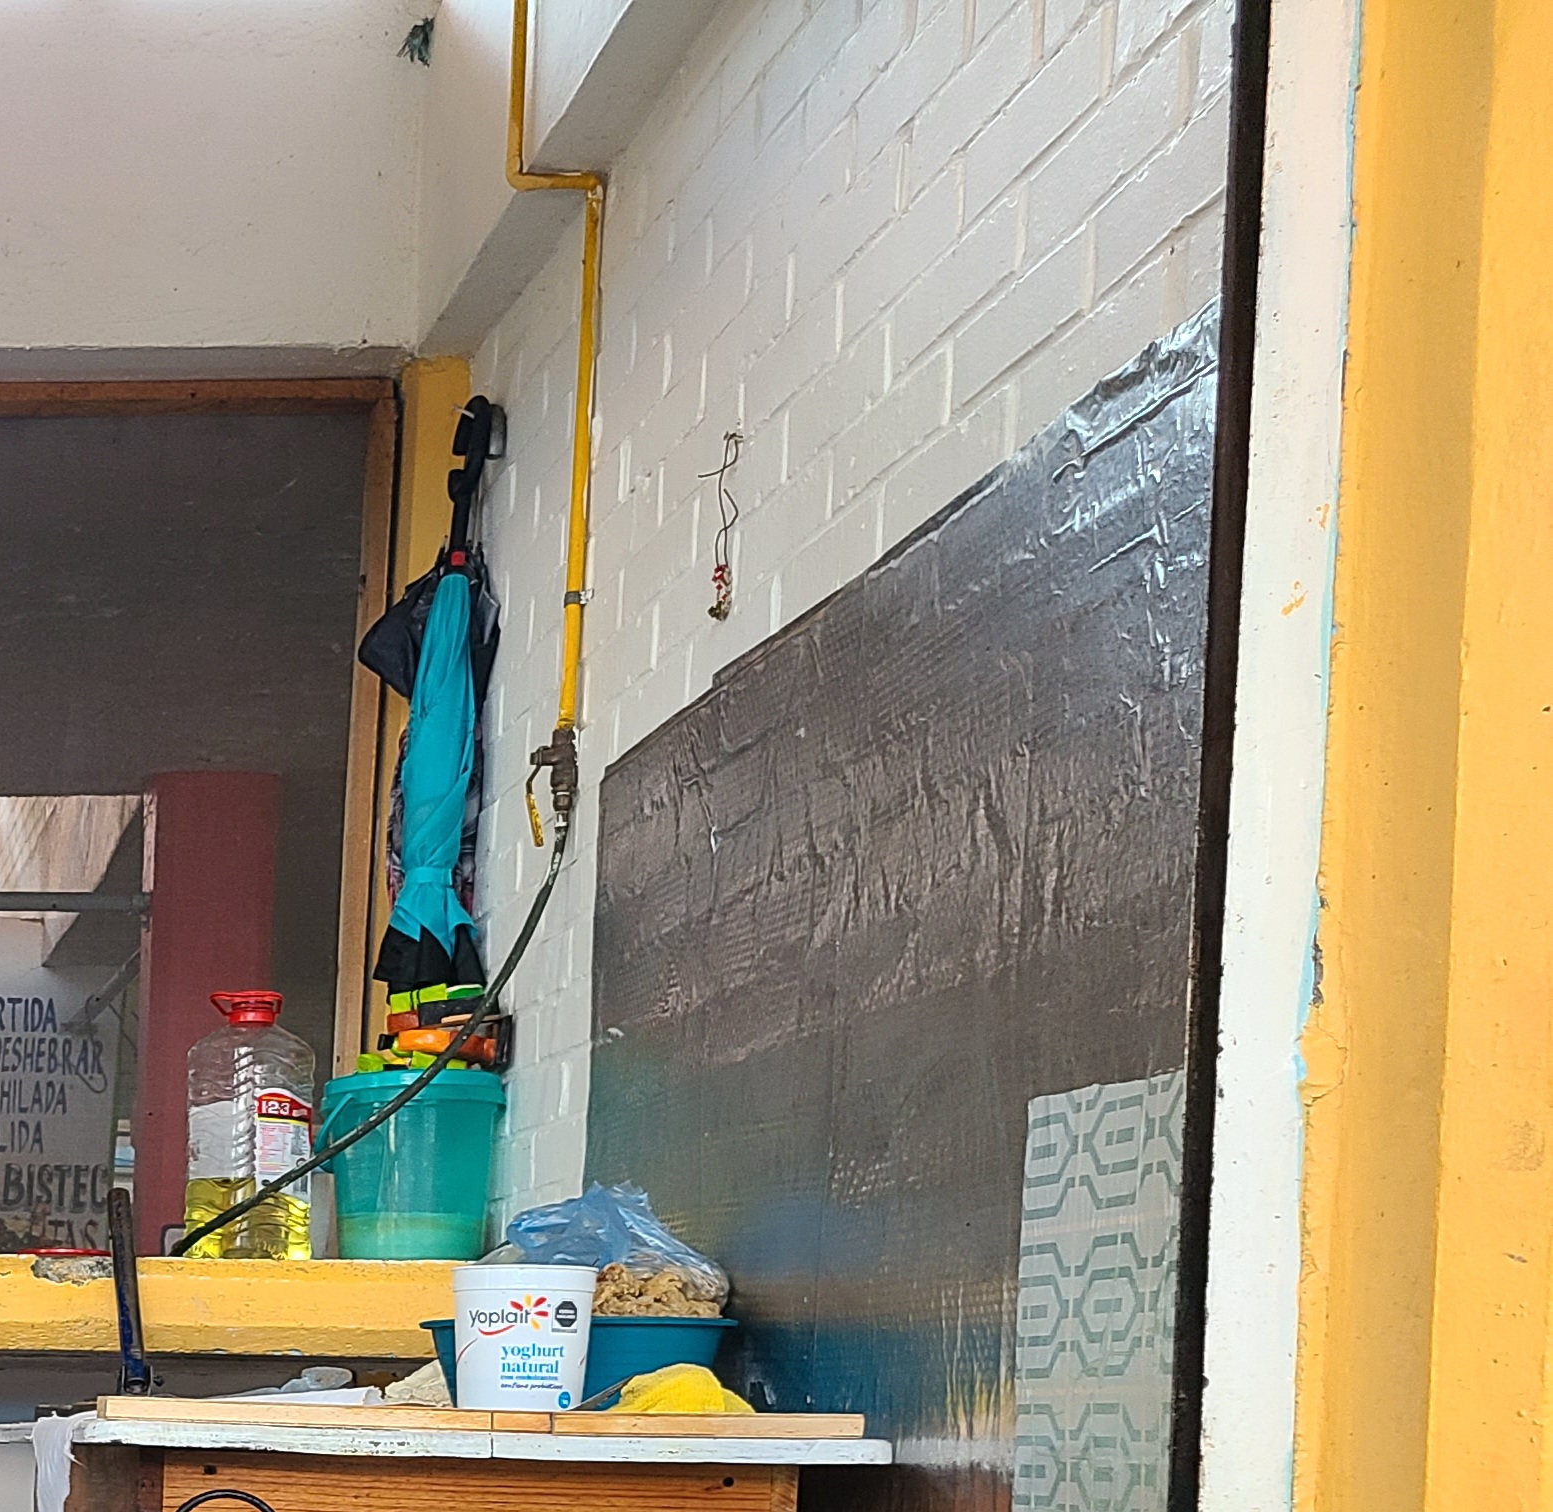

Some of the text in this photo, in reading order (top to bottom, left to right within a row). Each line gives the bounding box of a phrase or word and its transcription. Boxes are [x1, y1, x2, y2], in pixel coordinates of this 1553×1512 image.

[0, 1161, 109, 1212] BISTEC
[469, 1309, 531, 1328] yoplait
[500, 1343, 565, 1360] yoghurt
[500, 1360, 560, 1374] natural
